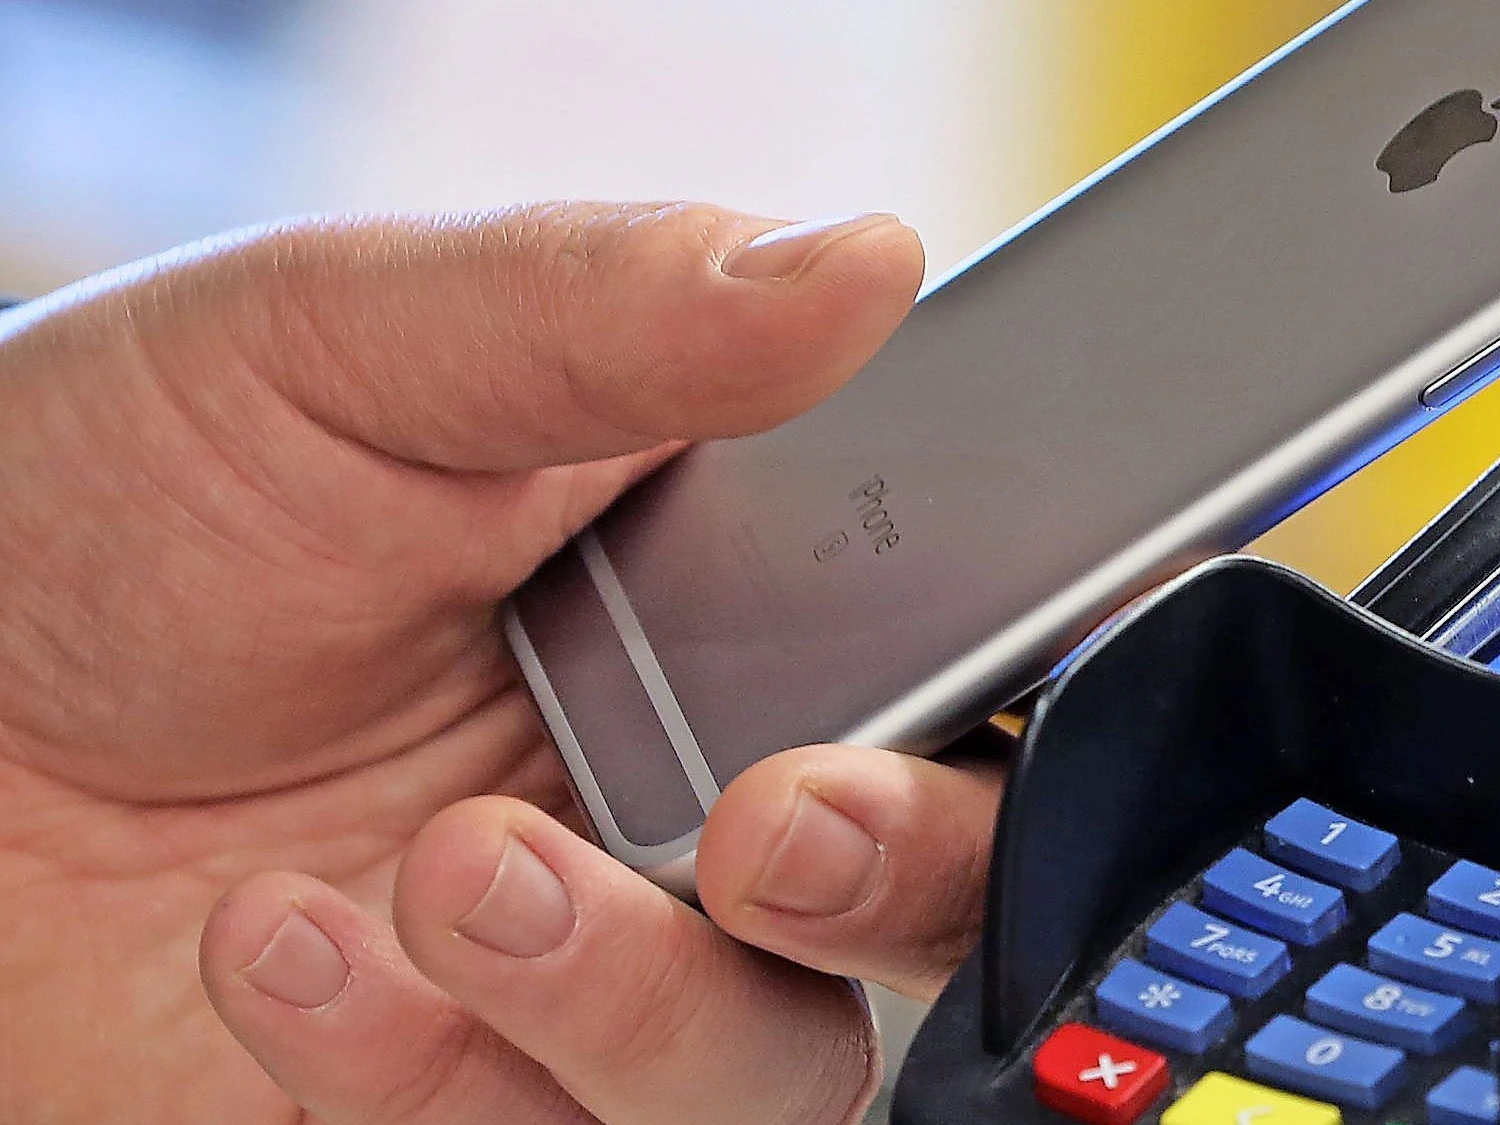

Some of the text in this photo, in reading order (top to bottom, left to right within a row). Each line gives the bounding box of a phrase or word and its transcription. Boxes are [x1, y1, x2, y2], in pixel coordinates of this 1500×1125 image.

[848, 474, 904, 555] iPhone
[1320, 822, 1348, 845] 1
[1253, 873, 1286, 898] 4
[1190, 922, 1230, 949] 7
[1423, 931, 1464, 959] 5
[1362, 984, 1402, 1012] 8
